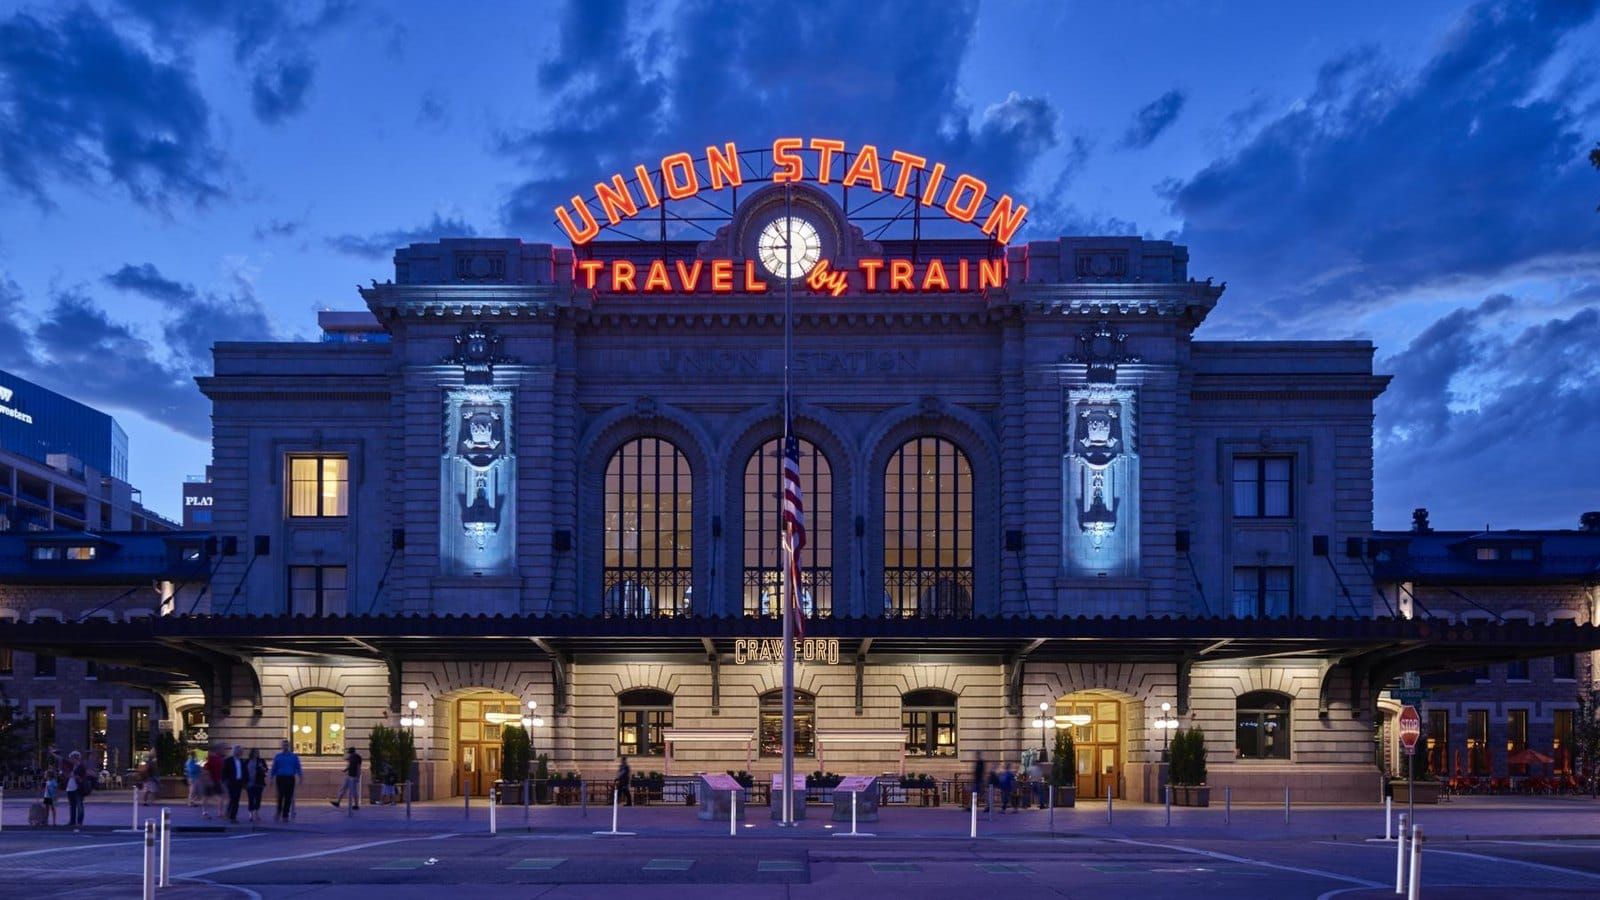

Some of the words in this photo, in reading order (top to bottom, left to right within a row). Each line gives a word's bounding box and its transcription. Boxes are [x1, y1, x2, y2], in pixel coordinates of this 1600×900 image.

[554, 142, 742, 246] UNION
[773, 137, 1029, 245] STATION
[577, 259, 767, 292] TRAVEL
[806, 259, 849, 297] by
[859, 258, 1007, 291] TRAIN
[659, 347, 760, 373] UNION
[792, 349, 921, 373] STATION
[1400, 718, 1418, 730] STOP
